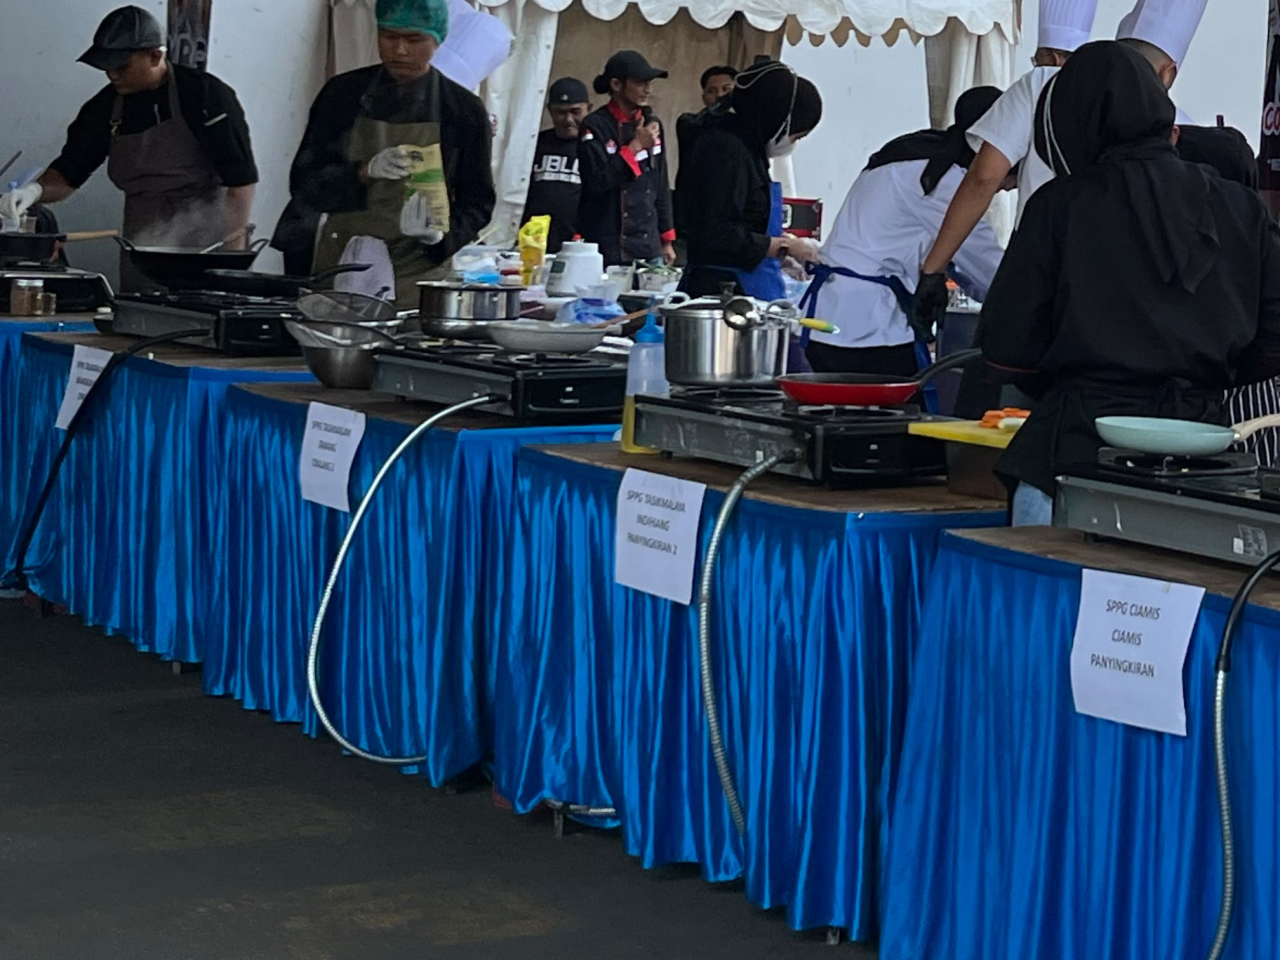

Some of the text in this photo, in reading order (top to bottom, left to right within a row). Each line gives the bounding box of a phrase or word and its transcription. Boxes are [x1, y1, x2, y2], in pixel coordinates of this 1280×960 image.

[627, 490, 686, 513] SPPG TASIKMALAYA
[1106, 599, 1161, 620] SPPG CIAMIS
[1112, 629, 1142, 646] CIAMIS
[1091, 654, 1155, 678] PANYINGKIRAN
